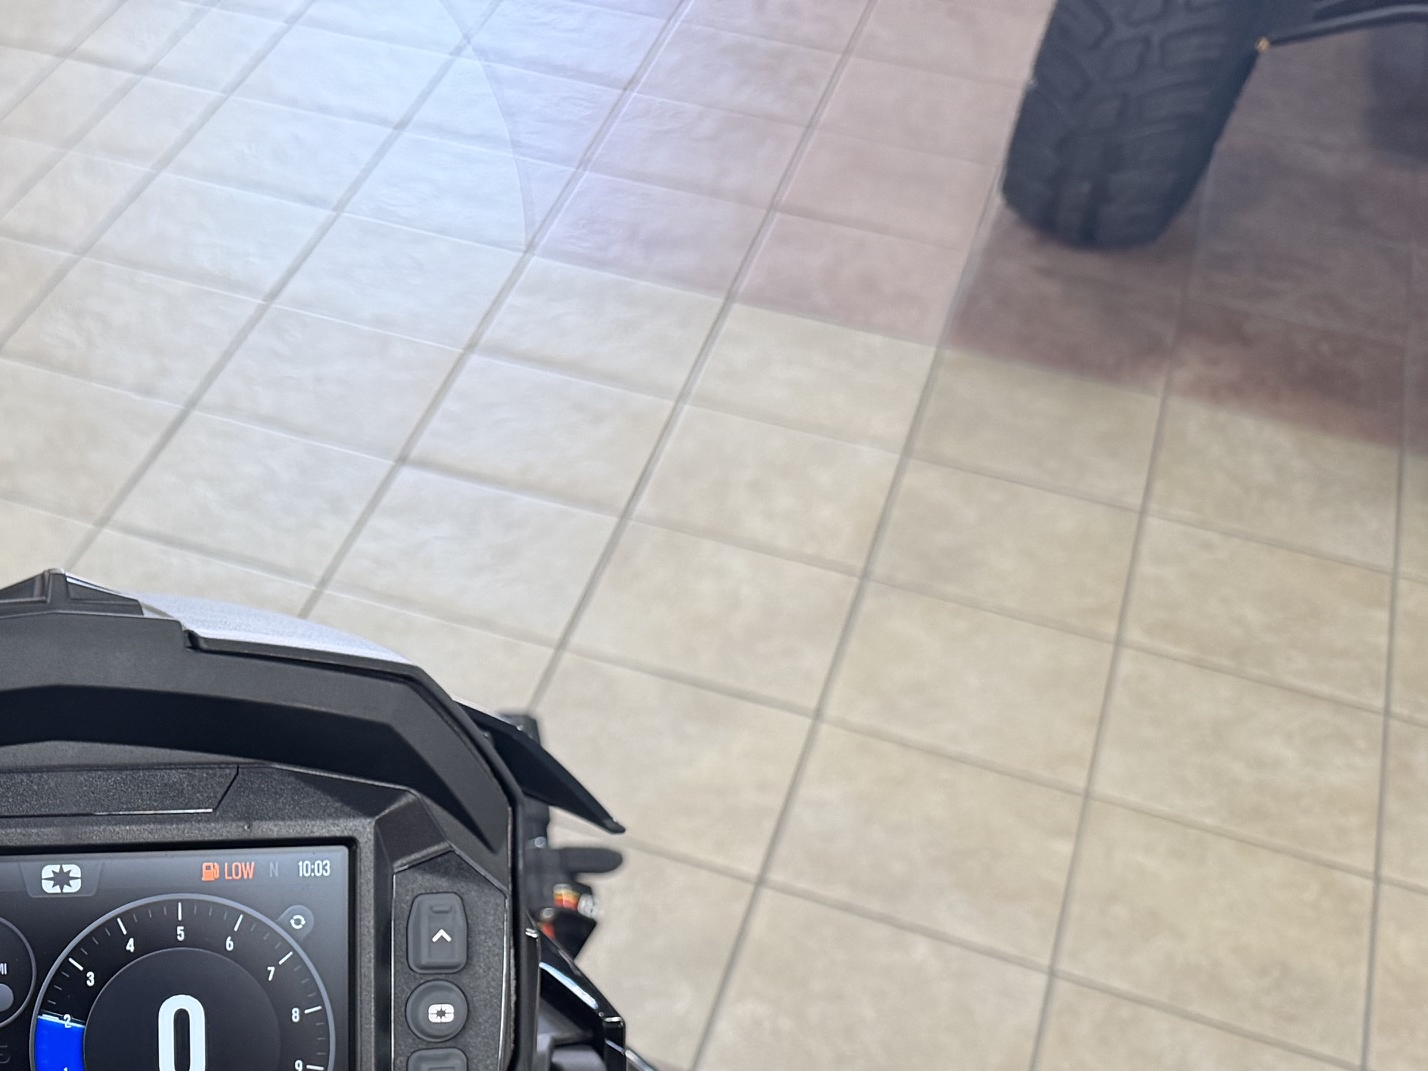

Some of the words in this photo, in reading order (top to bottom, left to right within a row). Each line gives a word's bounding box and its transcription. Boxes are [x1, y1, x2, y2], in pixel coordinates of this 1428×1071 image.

[224, 861, 255, 880] LOW
[297, 860, 331, 877] 10:03
[176, 926, 185, 941] 5
[125, 938, 135, 953] 4
[225, 936, 234, 951] 6
[86, 971, 95, 987] 3
[266, 967, 276, 982] 7
[63, 1014, 72, 1029] 2
[291, 1007, 300, 1023] 8
